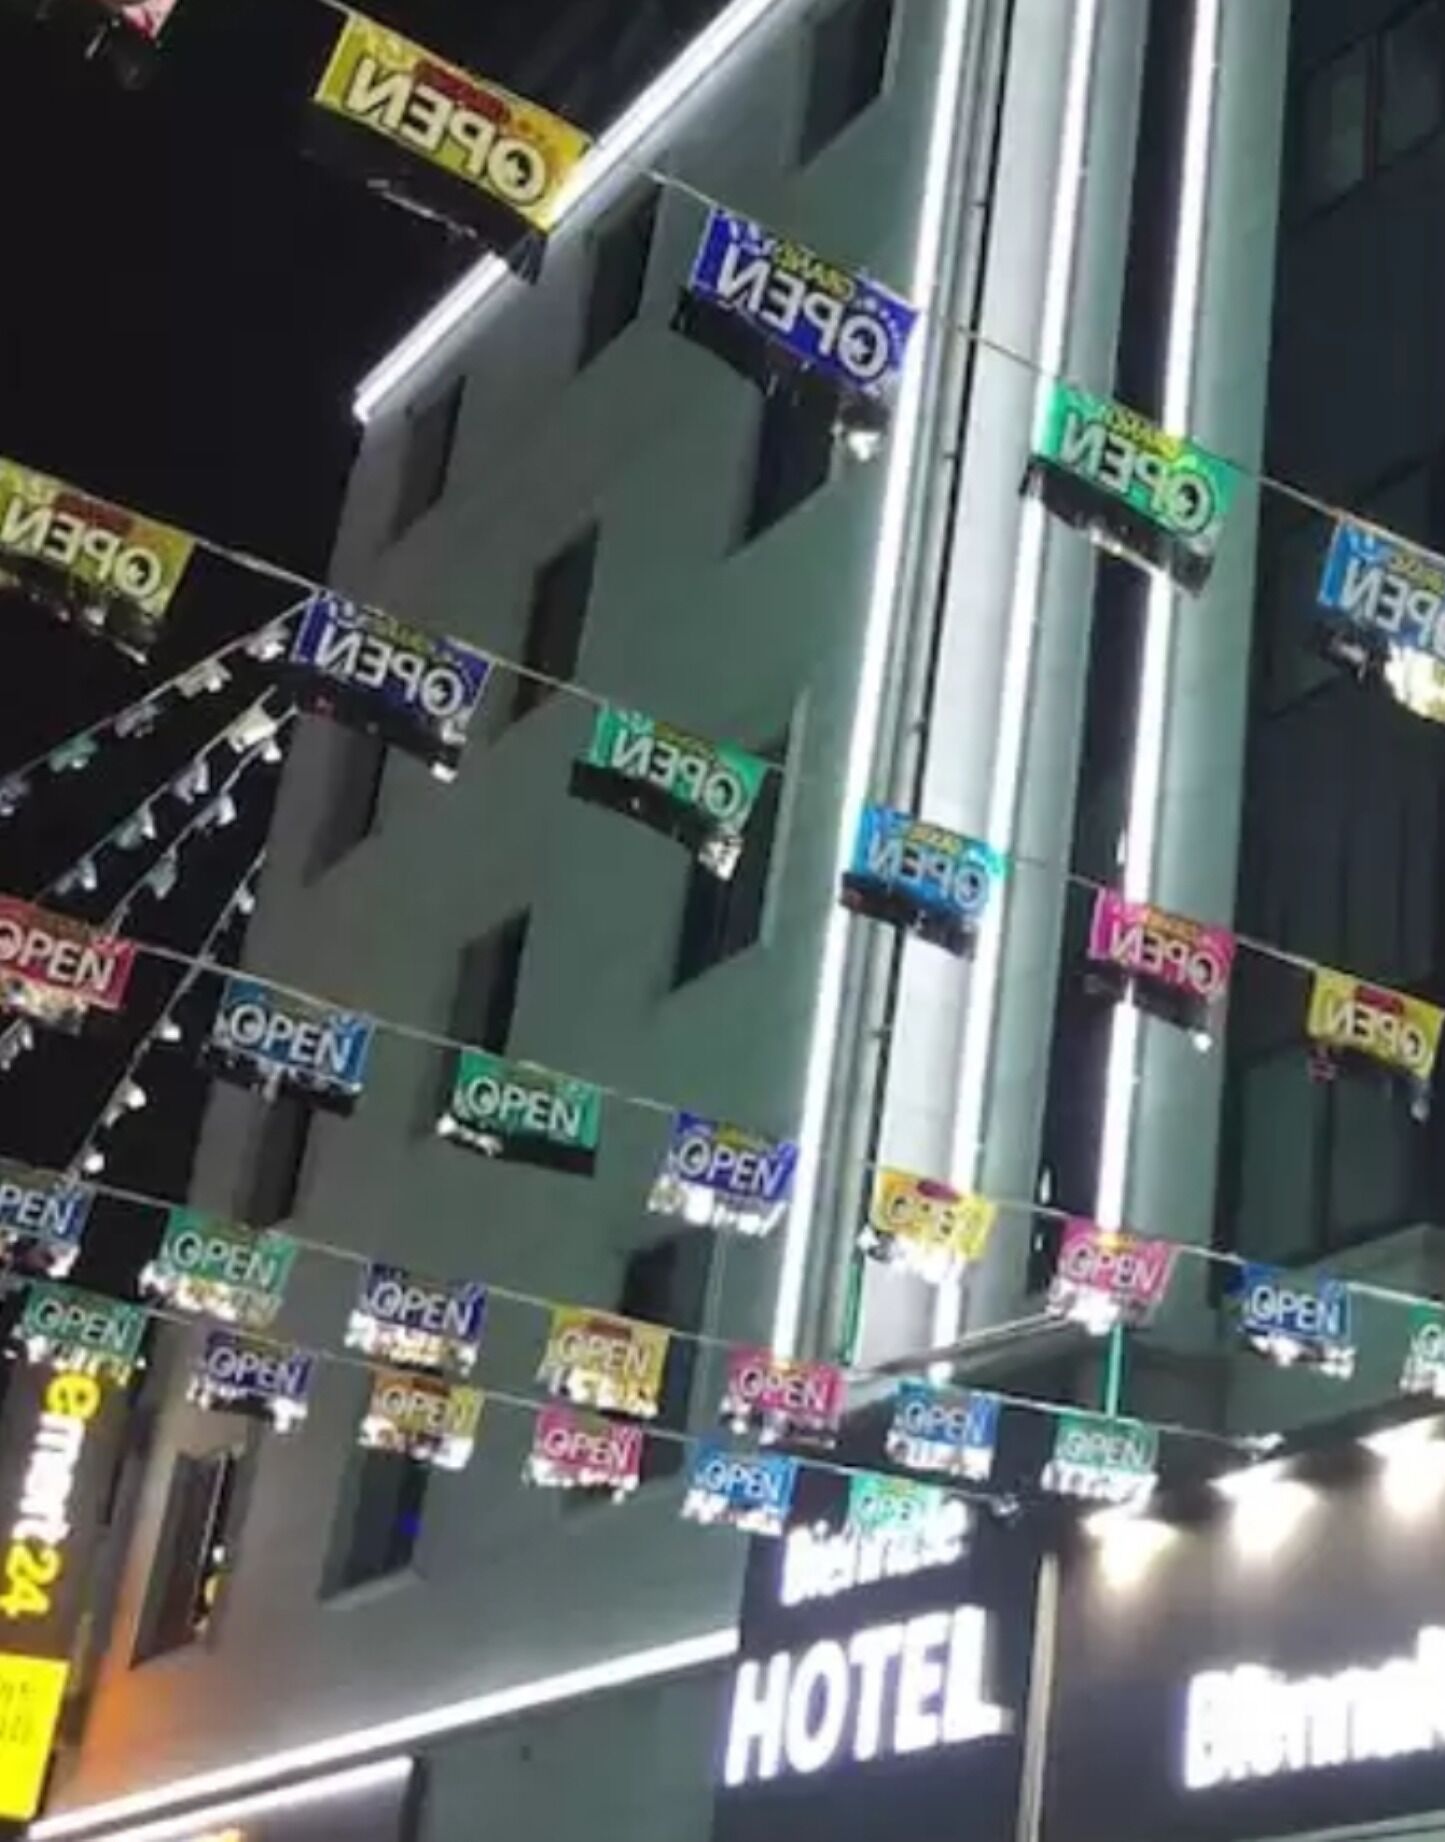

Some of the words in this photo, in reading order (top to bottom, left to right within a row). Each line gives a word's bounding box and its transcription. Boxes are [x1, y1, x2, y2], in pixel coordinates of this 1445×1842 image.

[0, 920, 115, 990] OPEN
[230, 1002, 350, 1073] OPEN
[467, 1076, 581, 1138] OPEN
[680, 1136, 782, 1196] OPEN
[172, 1233, 276, 1286] OPEN
[1061, 1241, 1158, 1294] OPEN
[34, 1300, 130, 1350] OPEN
[370, 1282, 474, 1334] OPEN
[1250, 1285, 1341, 1334] OPEN
[207, 1348, 302, 1392] OPEN
[556, 1327, 651, 1382] OPEN
[738, 1364, 829, 1410] OPEN
[904, 1401, 985, 1442] OPEN
[543, 1431, 630, 1470] OPEN
[1066, 1432, 1142, 1468] OPEN
[704, 1460, 782, 1500] OPEN
[724, 1604, 1012, 1786] HOTEL
